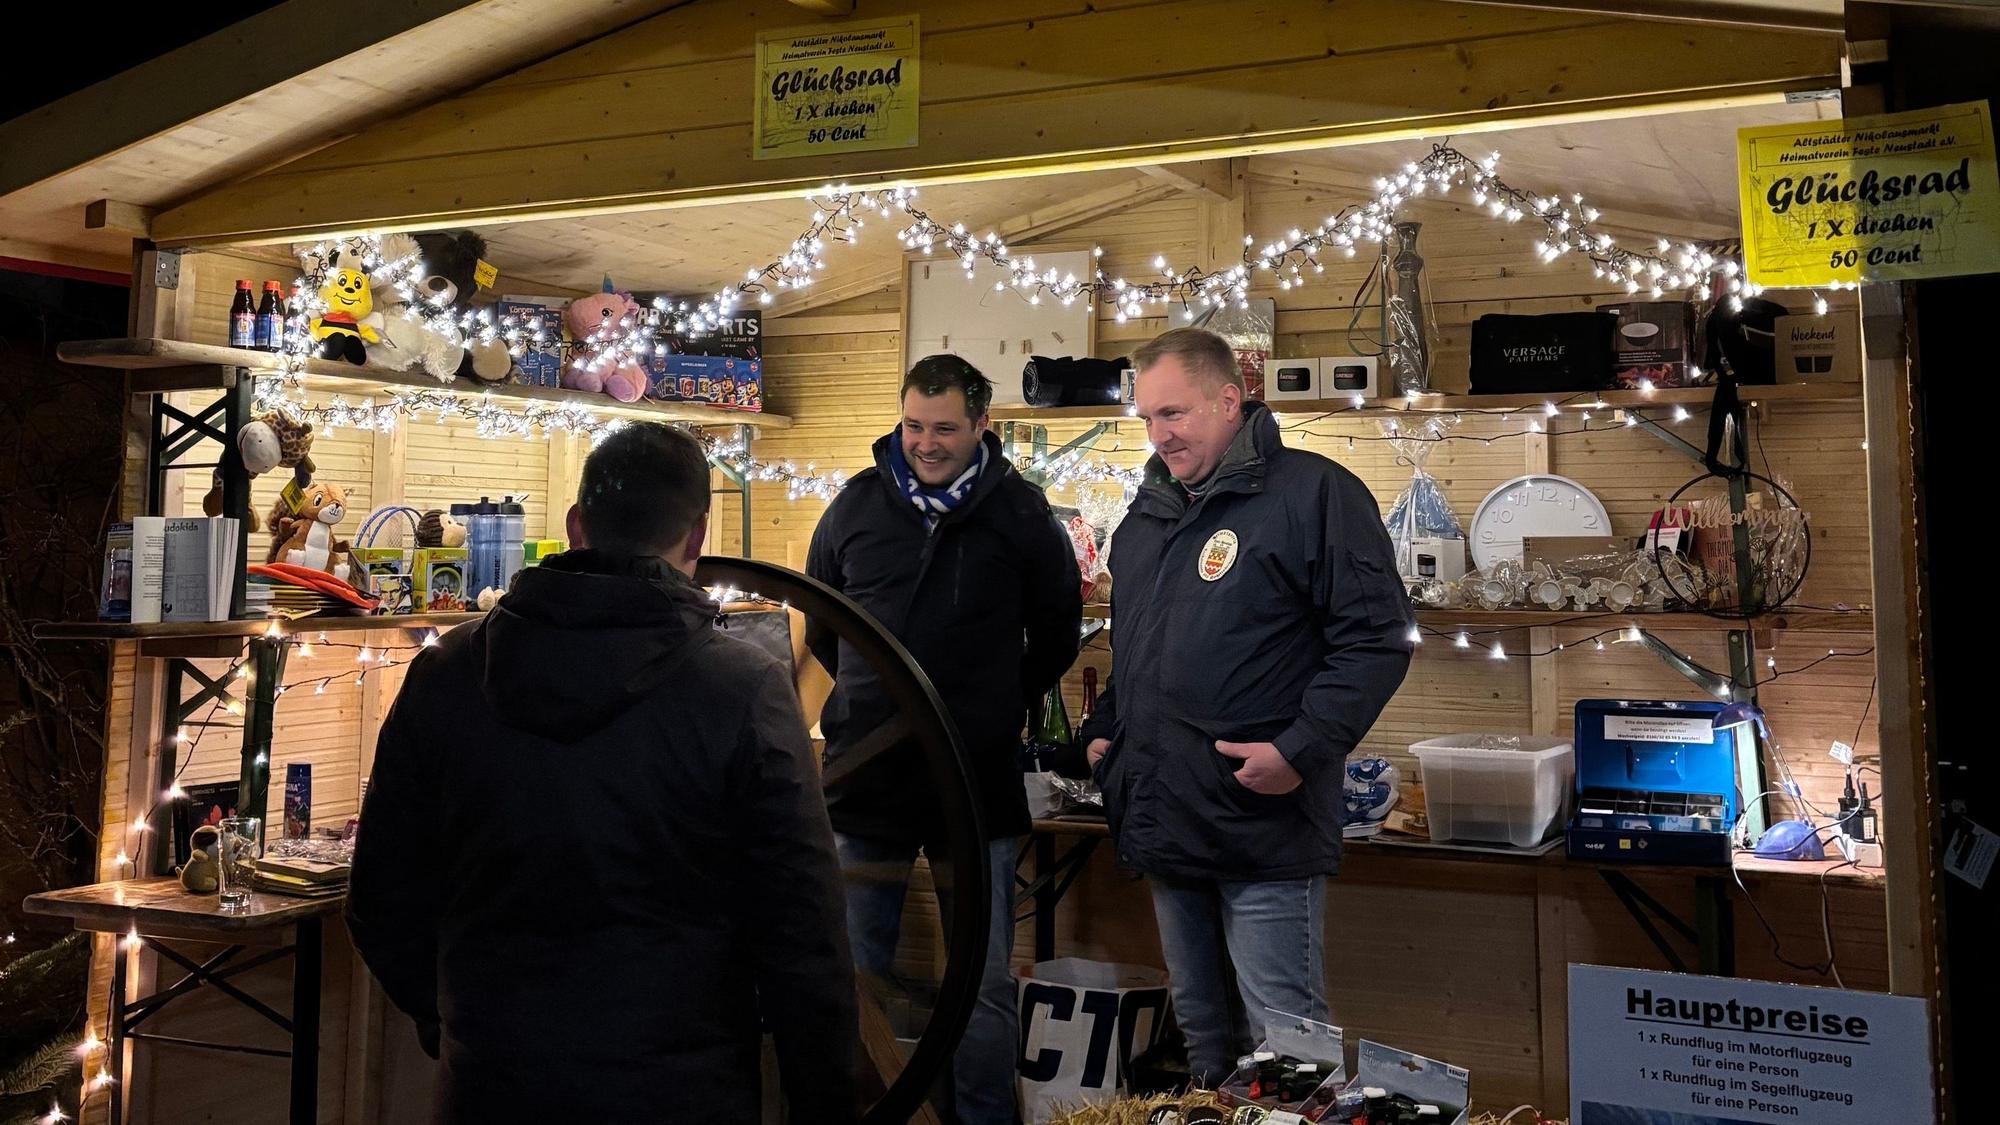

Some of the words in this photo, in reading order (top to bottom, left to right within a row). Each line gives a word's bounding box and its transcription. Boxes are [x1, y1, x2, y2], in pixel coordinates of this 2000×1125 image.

[782, 49, 827, 60] Heimatverein
[848, 43, 882, 53] Neustadt
[772, 58, 902, 101] Glücksrad
[795, 106, 802, 121] 1
[825, 100, 875, 118] drehen
[808, 128, 827, 143] 50
[831, 124, 866, 141] Cent
[1793, 133, 1851, 148] Altstädter
[1854, 123, 1940, 143] Nikolausmarkt
[1780, 147, 1850, 163] Heimatverein
[1853, 145, 1880, 157] Feste
[1883, 139, 1936, 153] Neustadt
[1767, 157, 1970, 214] Glücksrad
[1807, 222, 1816, 240] 1
[1853, 214, 1934, 236] drehen
[1830, 249, 1858, 269] 50
[1866, 244, 1922, 266] Cent
[1791, 325, 1836, 341] Weekend
[1503, 345, 1566, 357] VERSACE
[1514, 491, 1530, 507] 11
[1538, 485, 1559, 502] 12
[1569, 493, 1577, 511] 1
[1491, 510, 1514, 524] 10
[1583, 514, 1599, 529] 2
[1664, 491, 1812, 532] Willkommen
[164, 521, 199, 533] udokids
[1481, 530, 1497, 545] 9
[1627, 987, 1870, 1038] Hauptpreise
[1638, 1031, 1645, 1043] 1
[1649, 1034, 1658, 1044] x
[1661, 1032, 1724, 1054] Rundflug
[1728, 1040, 1745, 1053] im
[1749, 1042, 1853, 1067] Motorflugzeug
[1691, 1054, 1713, 1068] für
[1715, 1058, 1746, 1072] eine
[1749, 1061, 1799, 1078] Person
[1639, 1068, 1646, 1080] 1
[1651, 1071, 1659, 1081] x
[1662, 1069, 1726, 1091] Rundflug
[1730, 1077, 1747, 1091] im
[1750, 1080, 1854, 1106] Segelflugzeug
[1691, 1092, 1713, 1105] für
[1715, 1096, 1745, 1110] eine
[1749, 1099, 1799, 1116] Person
